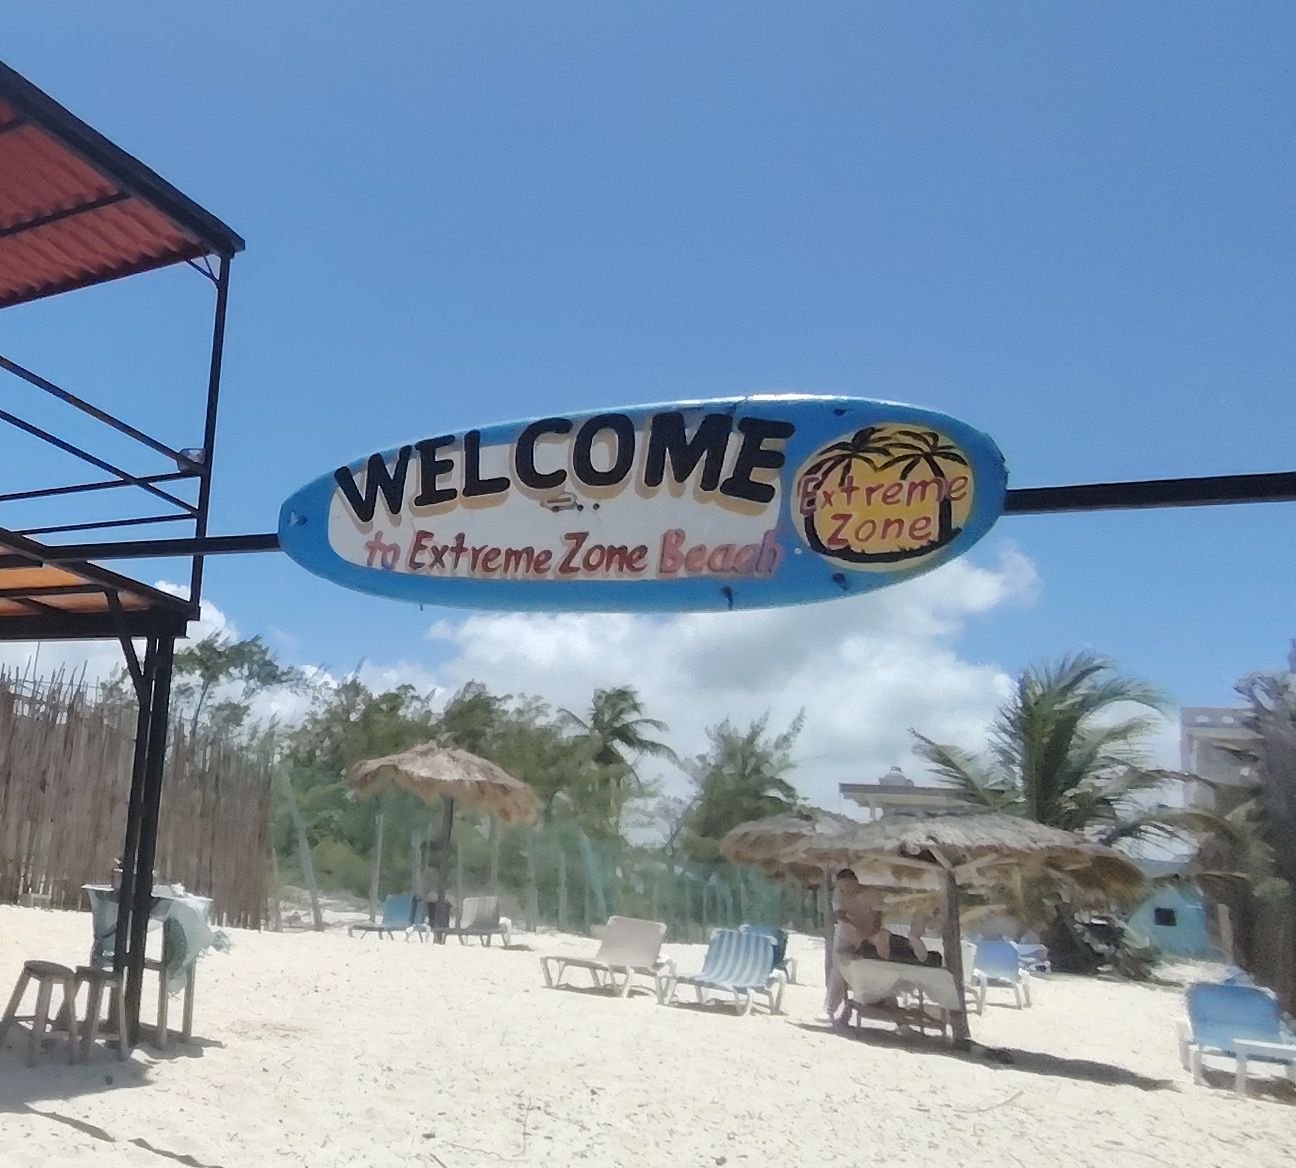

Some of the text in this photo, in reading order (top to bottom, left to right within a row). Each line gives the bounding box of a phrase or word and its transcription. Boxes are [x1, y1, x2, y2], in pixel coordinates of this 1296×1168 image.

[334, 413, 795, 523] WELCOME
[799, 474, 969, 516] Extreme
[365, 527, 781, 577] to Extreme Zone Beach
[825, 512, 933, 547] Zone
